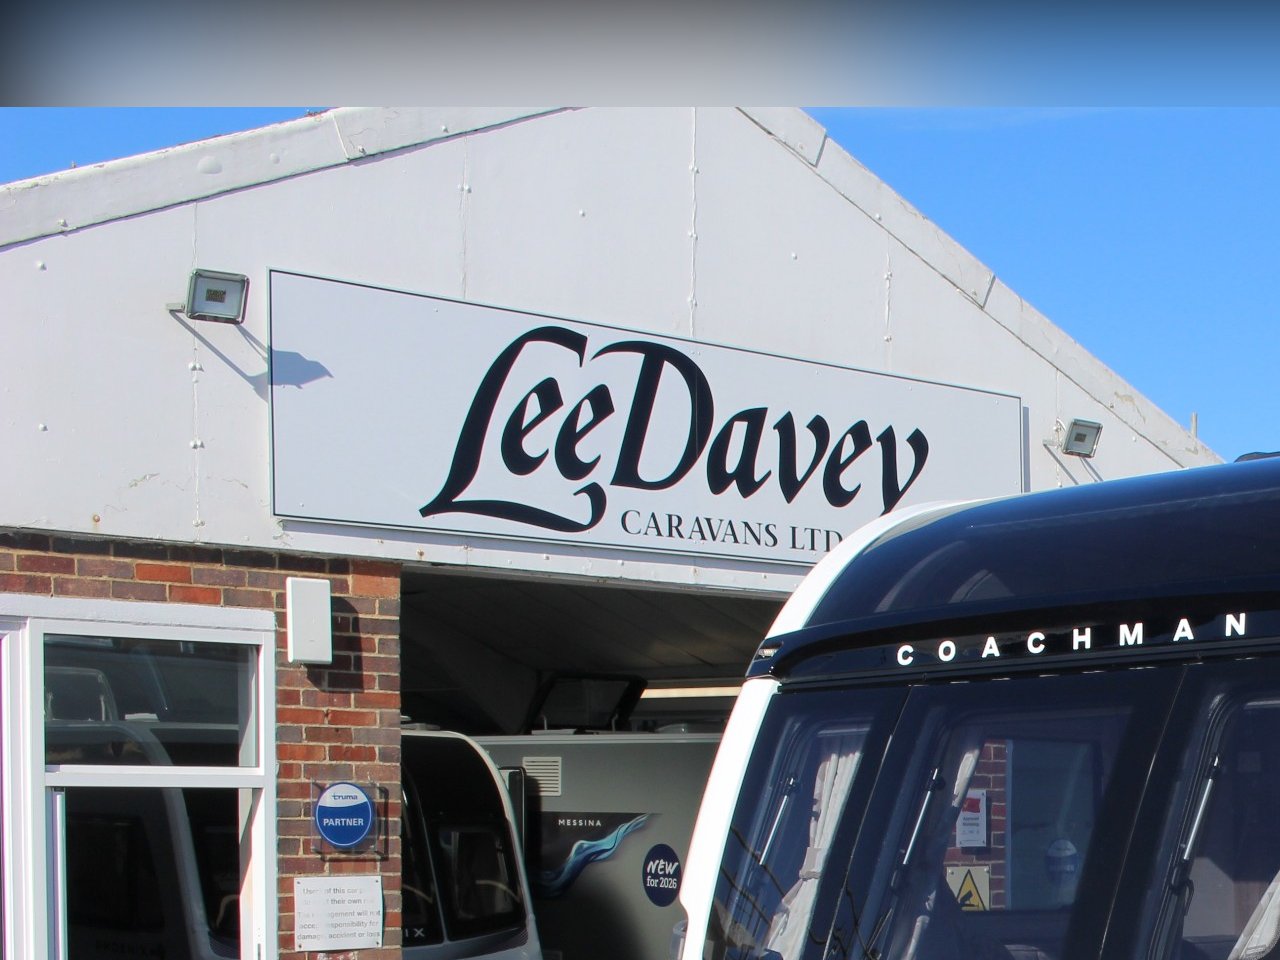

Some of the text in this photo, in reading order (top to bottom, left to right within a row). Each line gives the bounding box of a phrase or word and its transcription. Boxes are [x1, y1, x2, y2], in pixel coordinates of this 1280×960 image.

[620, 509, 844, 553] CARAVANS LTD
[896, 612, 1246, 666] COACHMAN
[332, 792, 358, 800] truma
[323, 818, 364, 827] PARTNER
[558, 819, 602, 827] MESSINA
[646, 859, 679, 875] NEW
[646, 876, 678, 889] for 2026
